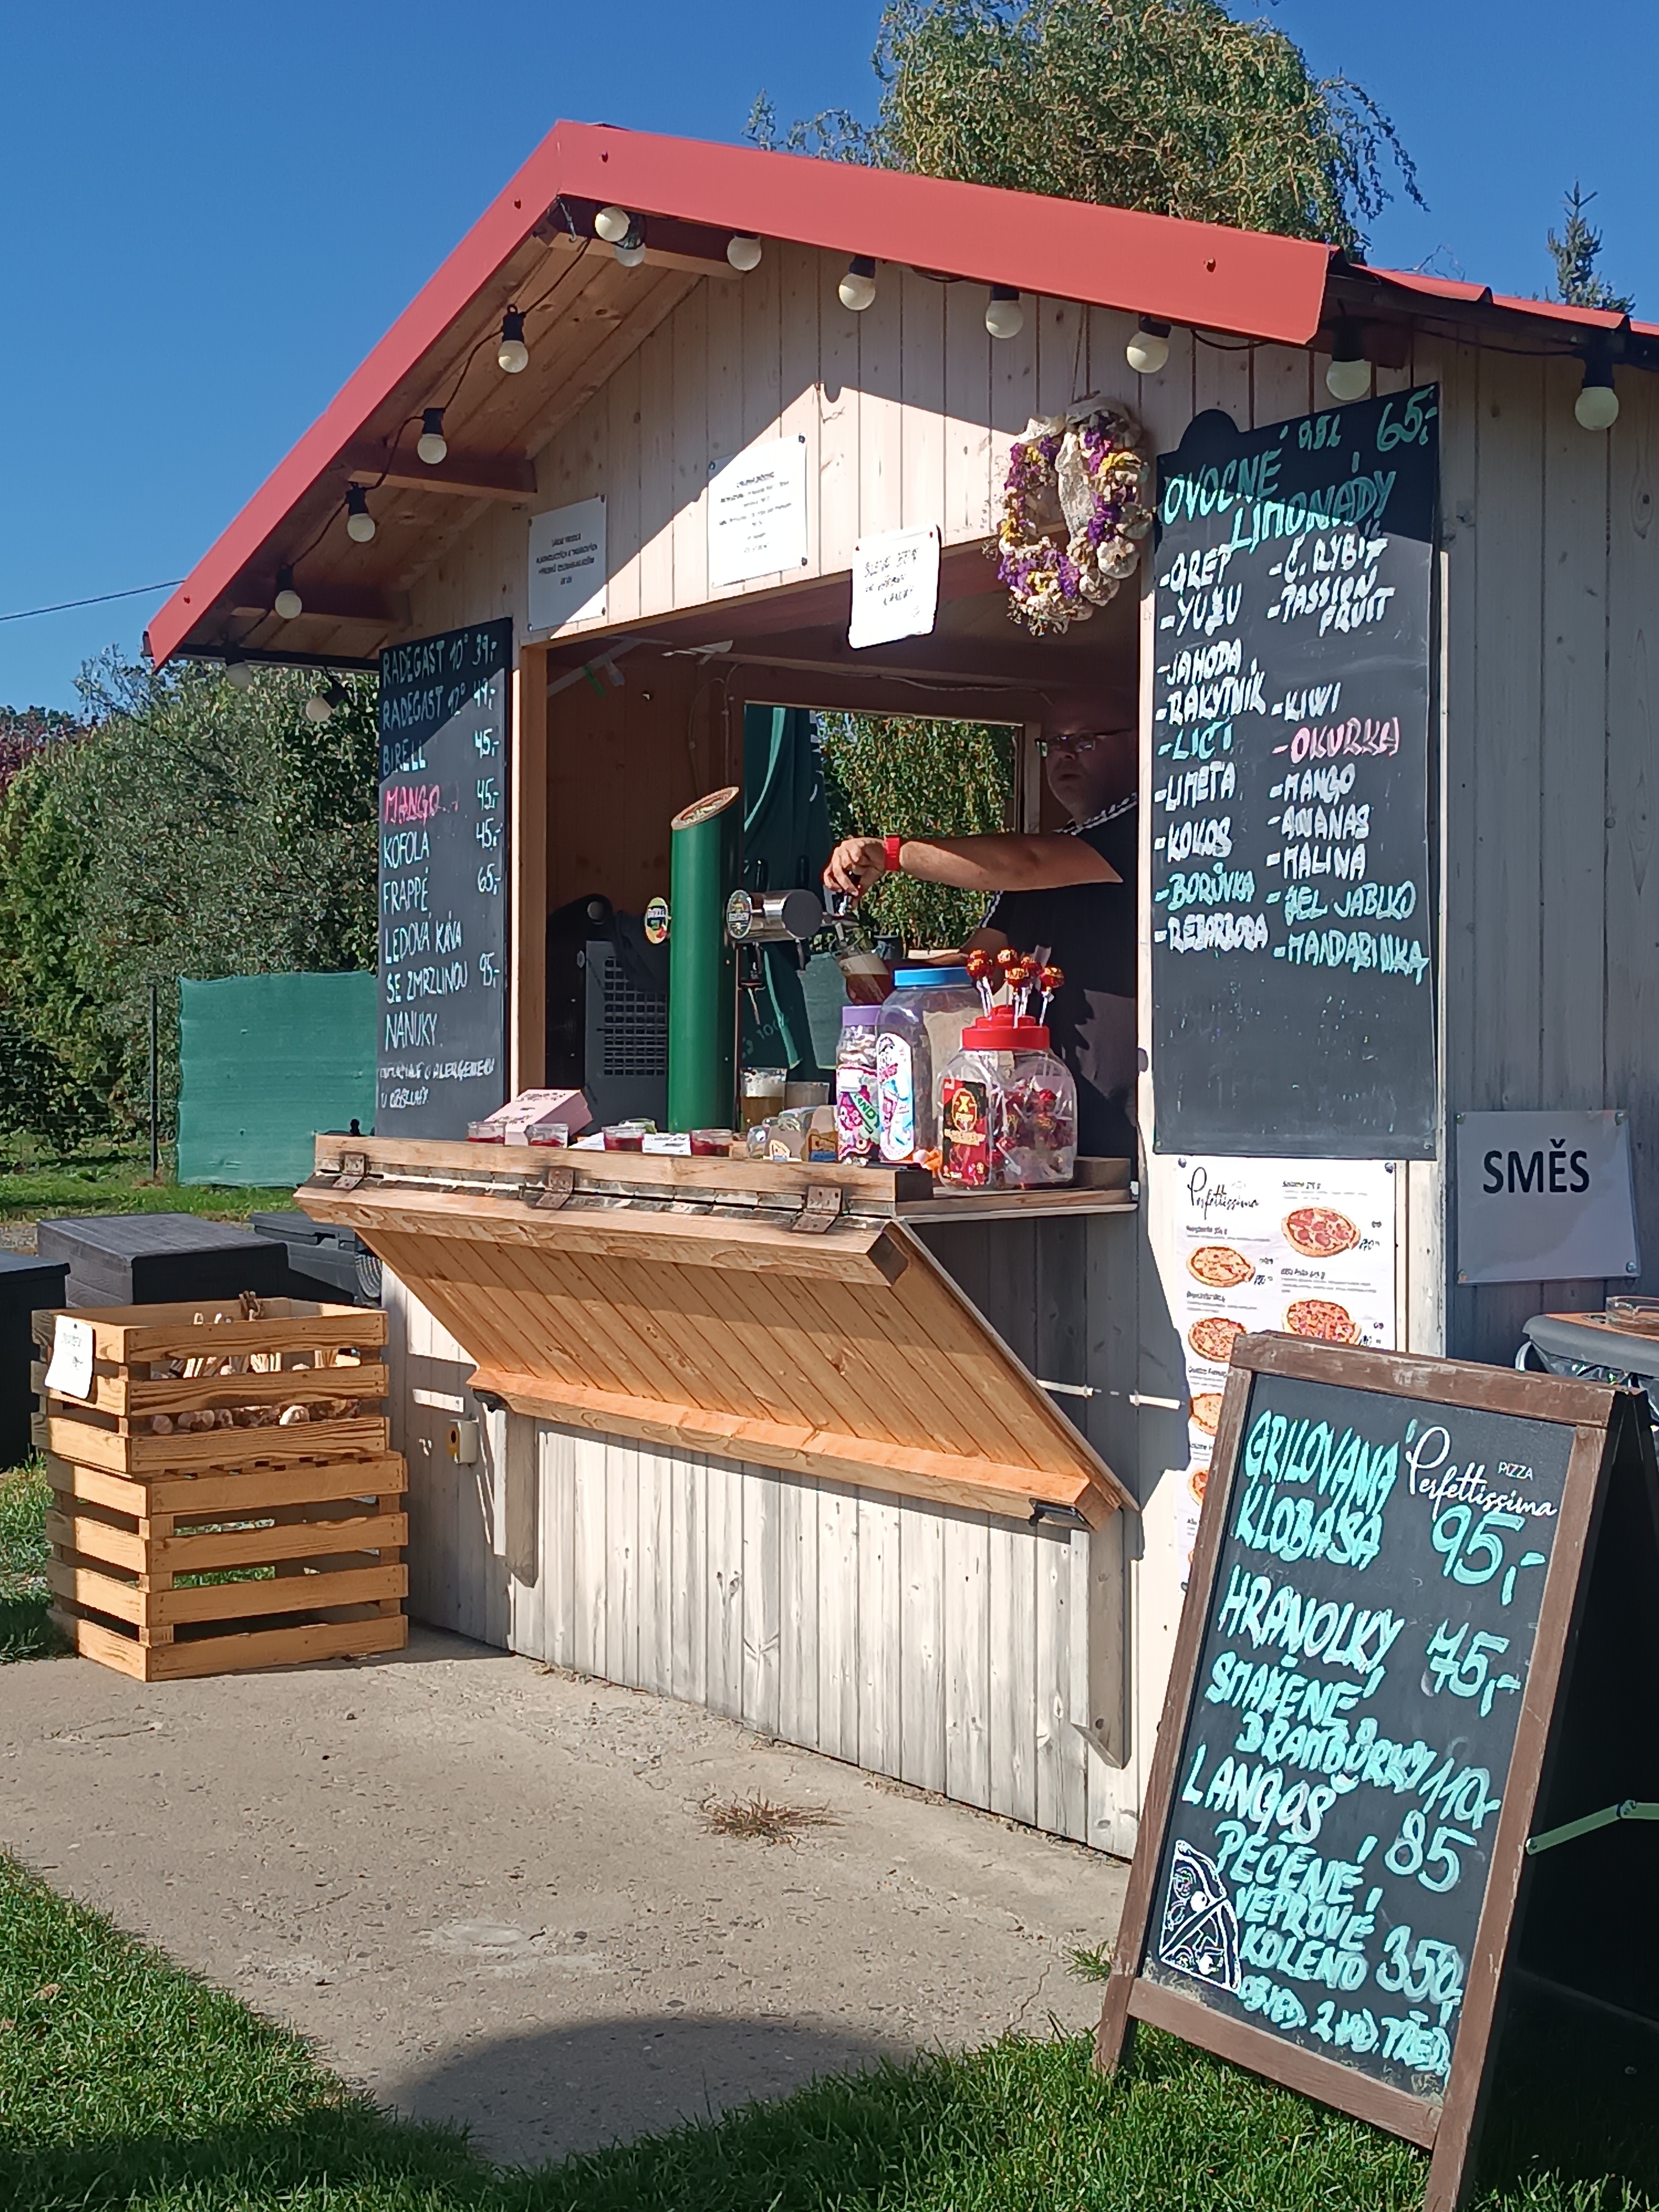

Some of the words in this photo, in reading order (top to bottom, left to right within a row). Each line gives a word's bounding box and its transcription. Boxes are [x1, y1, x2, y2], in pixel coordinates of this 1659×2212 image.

[1164, 425, 1288, 524] OVOCNÉ
[1230, 452, 1396, 554] LIMONÁDY
[1319, 587, 1396, 637] FRUIT
[383, 640, 445, 689] RADEGAST
[450, 633, 468, 671] 10°
[382, 685, 444, 731] RADEGAST
[383, 738, 426, 777] BIRELL
[384, 784, 440, 825] MANGO
[384, 830, 430, 869] KOFOLA
[383, 867, 430, 916] FRAPPÉ
[1333, 880, 1416, 920] JABLKO
[384, 911, 432, 964] LEDOVÁ
[435, 910, 462, 954] KÁVA
[386, 972, 402, 1004] SE
[406, 960, 468, 1001] ZMRZLINOU
[385, 1010, 438, 1052] NANUKY
[380, 1092, 388, 1109] U
[1483, 1139, 1590, 1194] SMĚS
[1245, 1410, 1418, 1516] GRILOVANÁ
[1405, 1426, 1558, 1522] Perfettissima
[1498, 1461, 1534, 1481] PIZZA
[1430, 1504, 1546, 1606] 95,-
[1218, 1564, 1406, 1673] HRANOLKY
[1384, 1809, 1478, 1892] 85
[1239, 1923, 1369, 1991] KOLENO
[1310, 2000, 1336, 2042] 2
